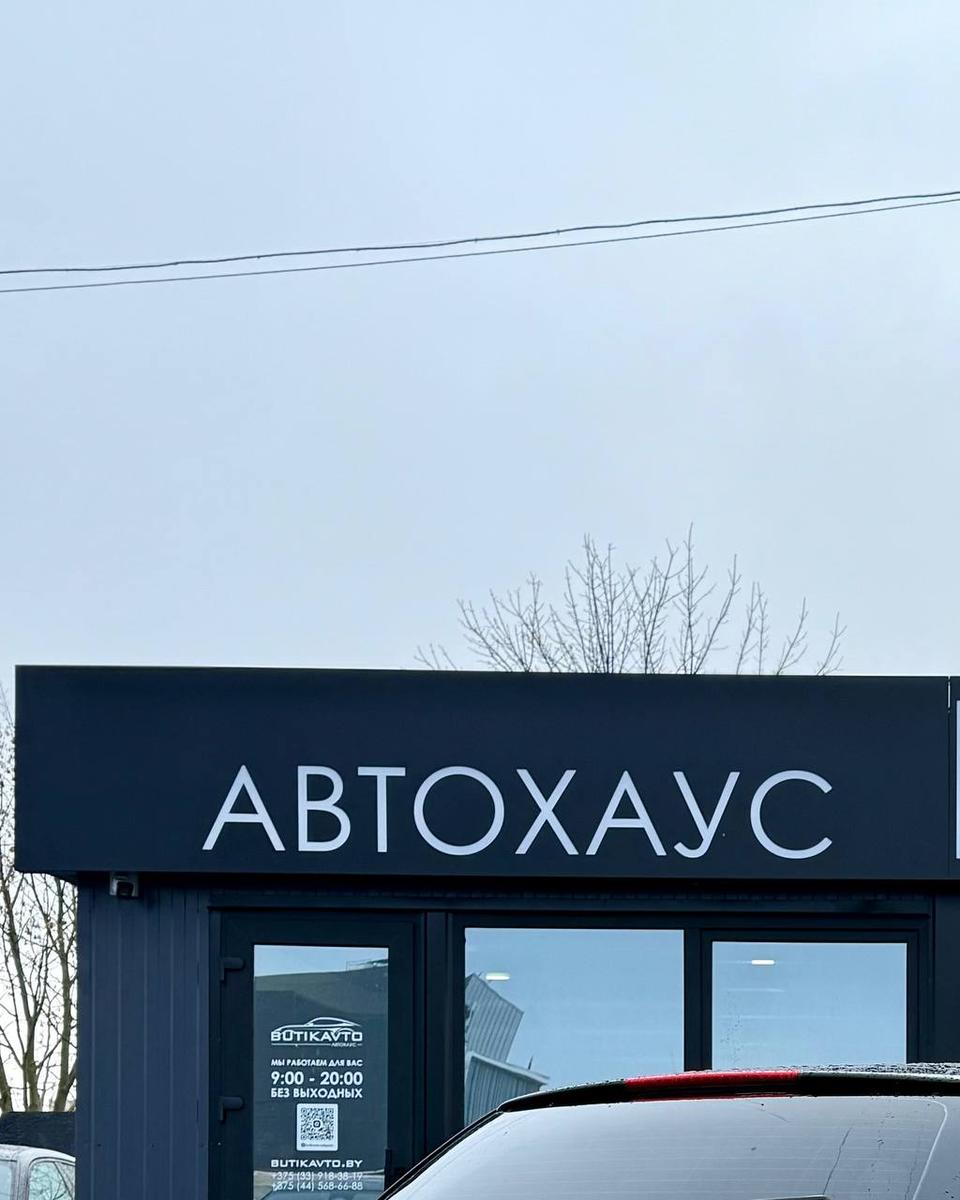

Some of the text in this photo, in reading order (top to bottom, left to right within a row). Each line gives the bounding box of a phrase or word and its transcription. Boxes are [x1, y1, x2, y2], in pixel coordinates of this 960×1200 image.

[202, 764, 833, 860] АВТОХАУС
[270, 1030, 363, 1042] BUTIKAVTO
[270, 1059, 363, 1068] МЫ РАБОТАЕМ ДЛЯ ВАС
[271, 1071, 304, 1086] 9:00
[320, 1071, 363, 1086] 20:00
[270, 1088, 363, 1099] БЕЗ ВЫХОДНЫХ
[270, 1159, 363, 1168] BUTIKAVTO.BY
[272, 1171, 363, 1182] +375 (33) 918-38-19
[297, 1181, 315, 1192] (44)
[317, 1181, 363, 1190] 568-66-88
